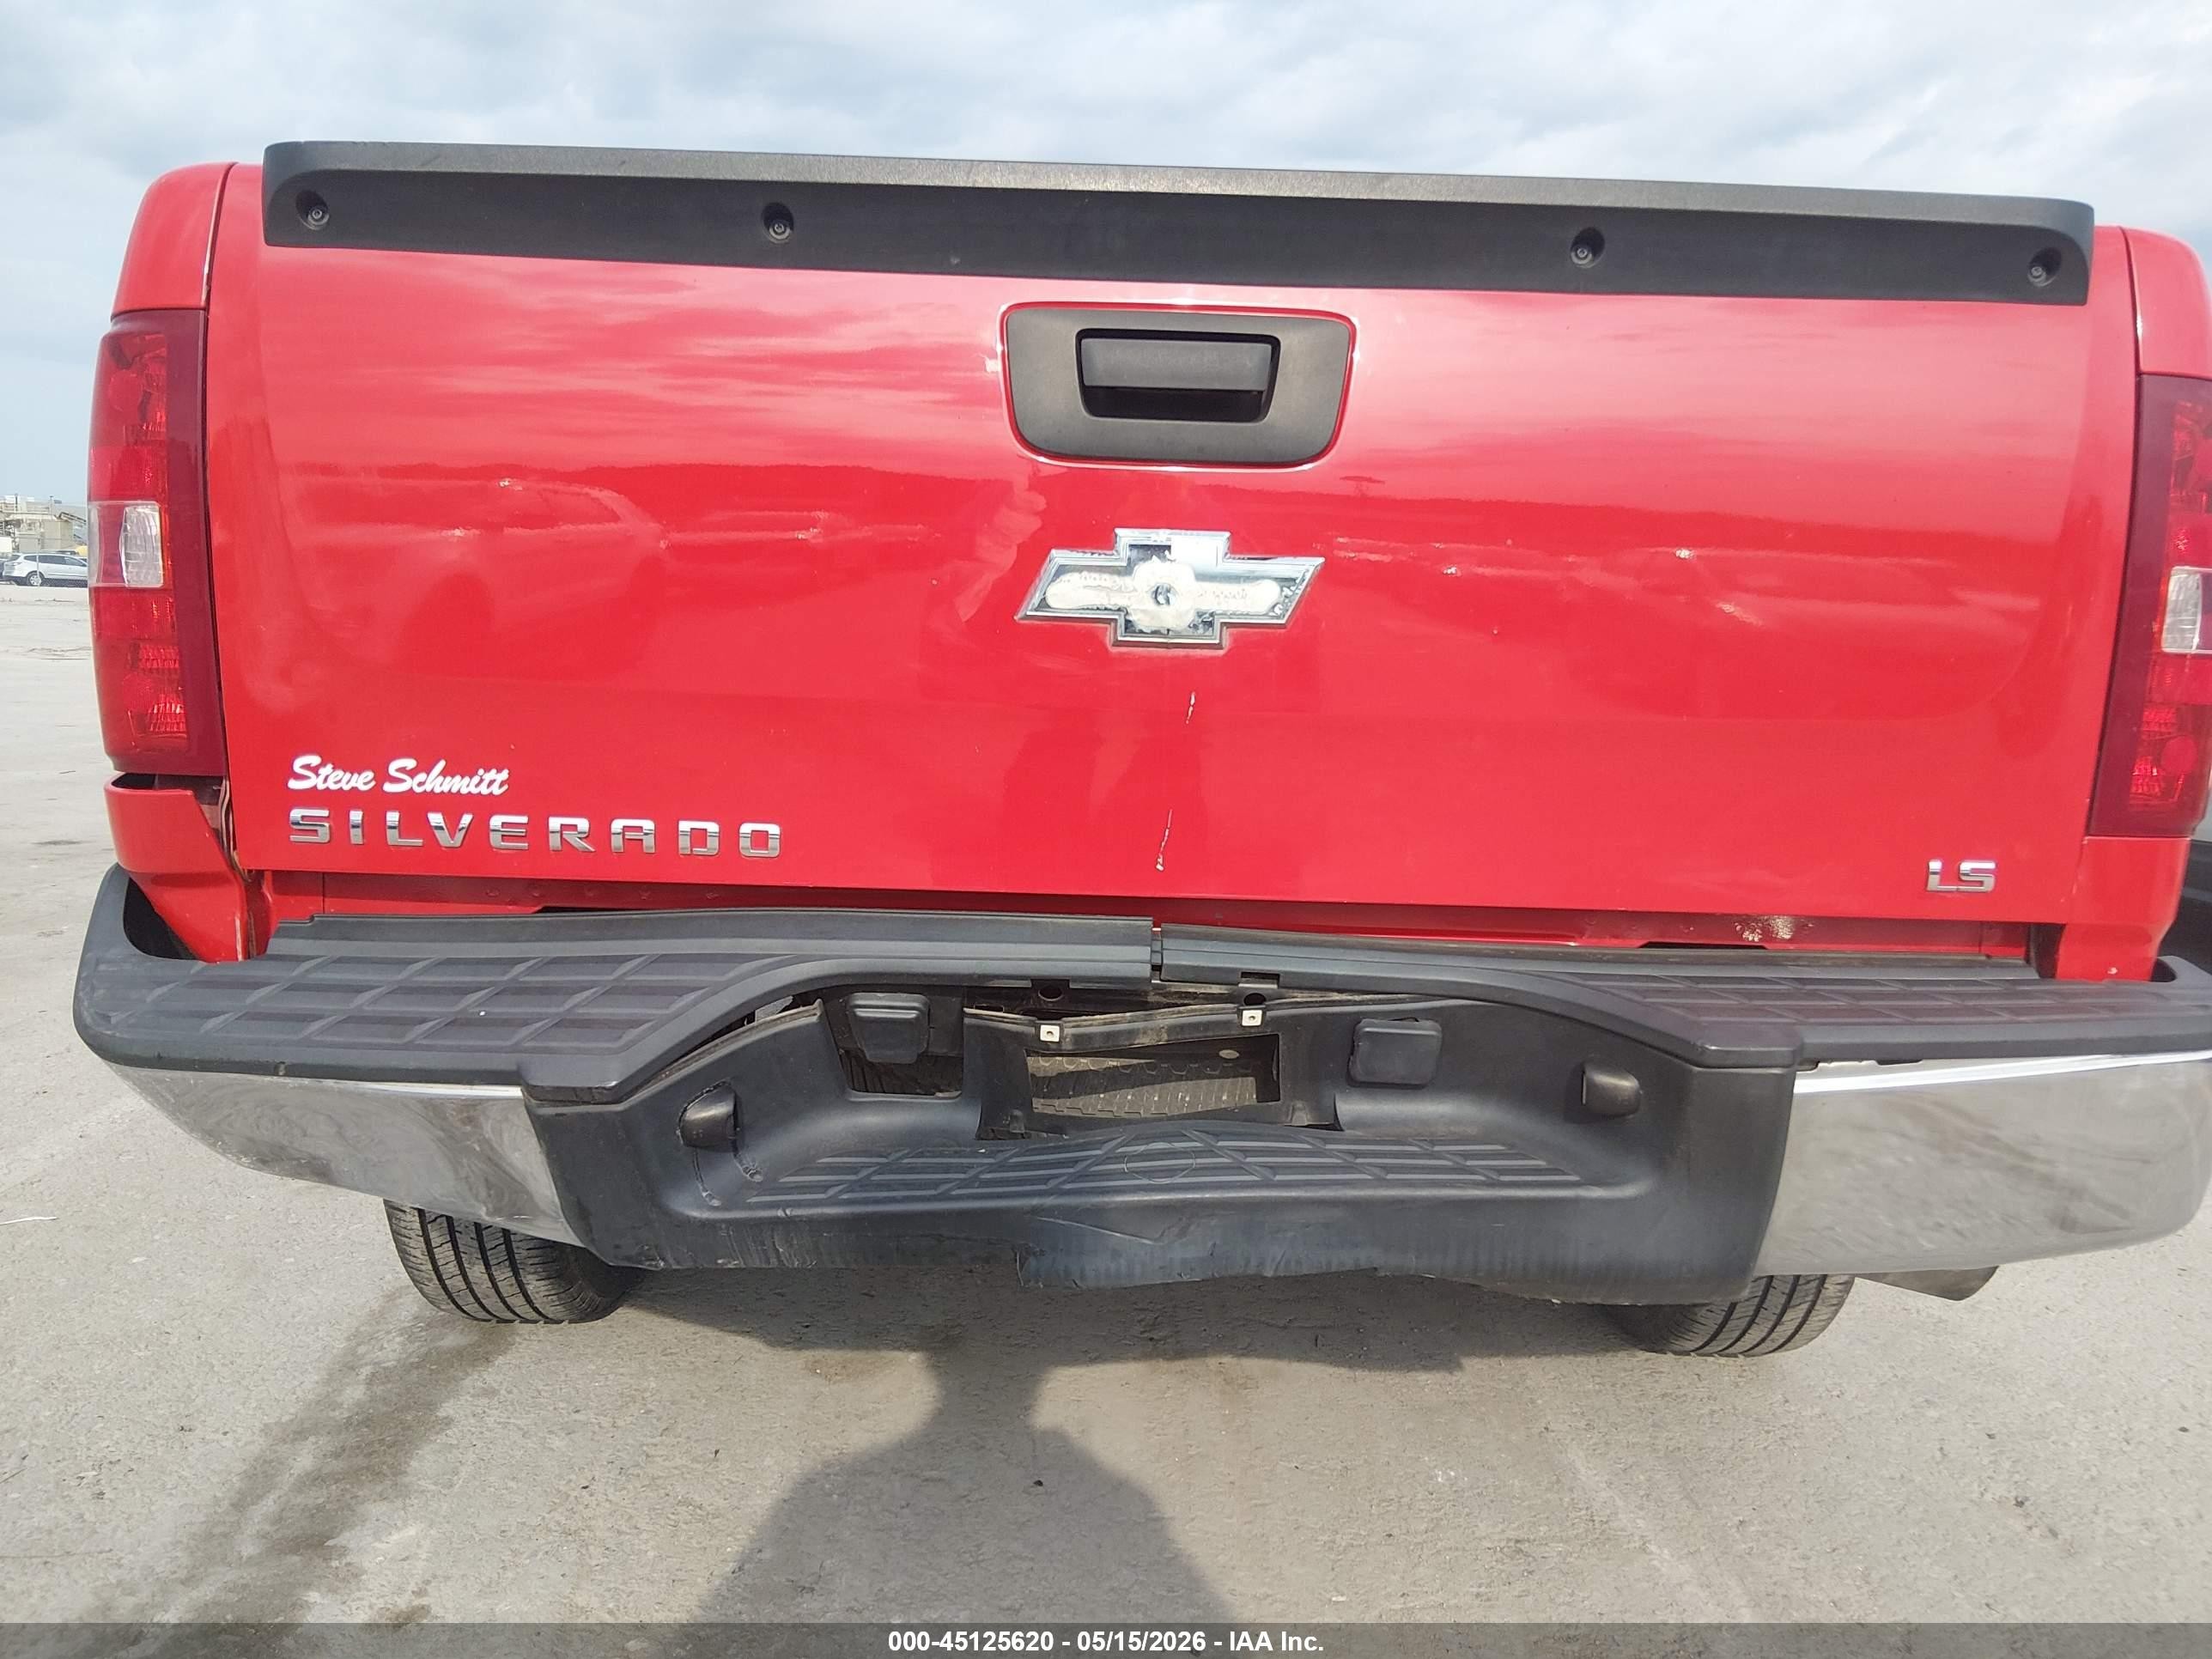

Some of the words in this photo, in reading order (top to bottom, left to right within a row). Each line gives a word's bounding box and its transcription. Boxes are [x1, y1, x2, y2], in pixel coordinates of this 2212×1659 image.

[287, 754, 376, 791] Steve
[382, 757, 509, 796] Schmitt
[289, 807, 781, 857] SILVERADO
[1926, 859, 1996, 892] LS
